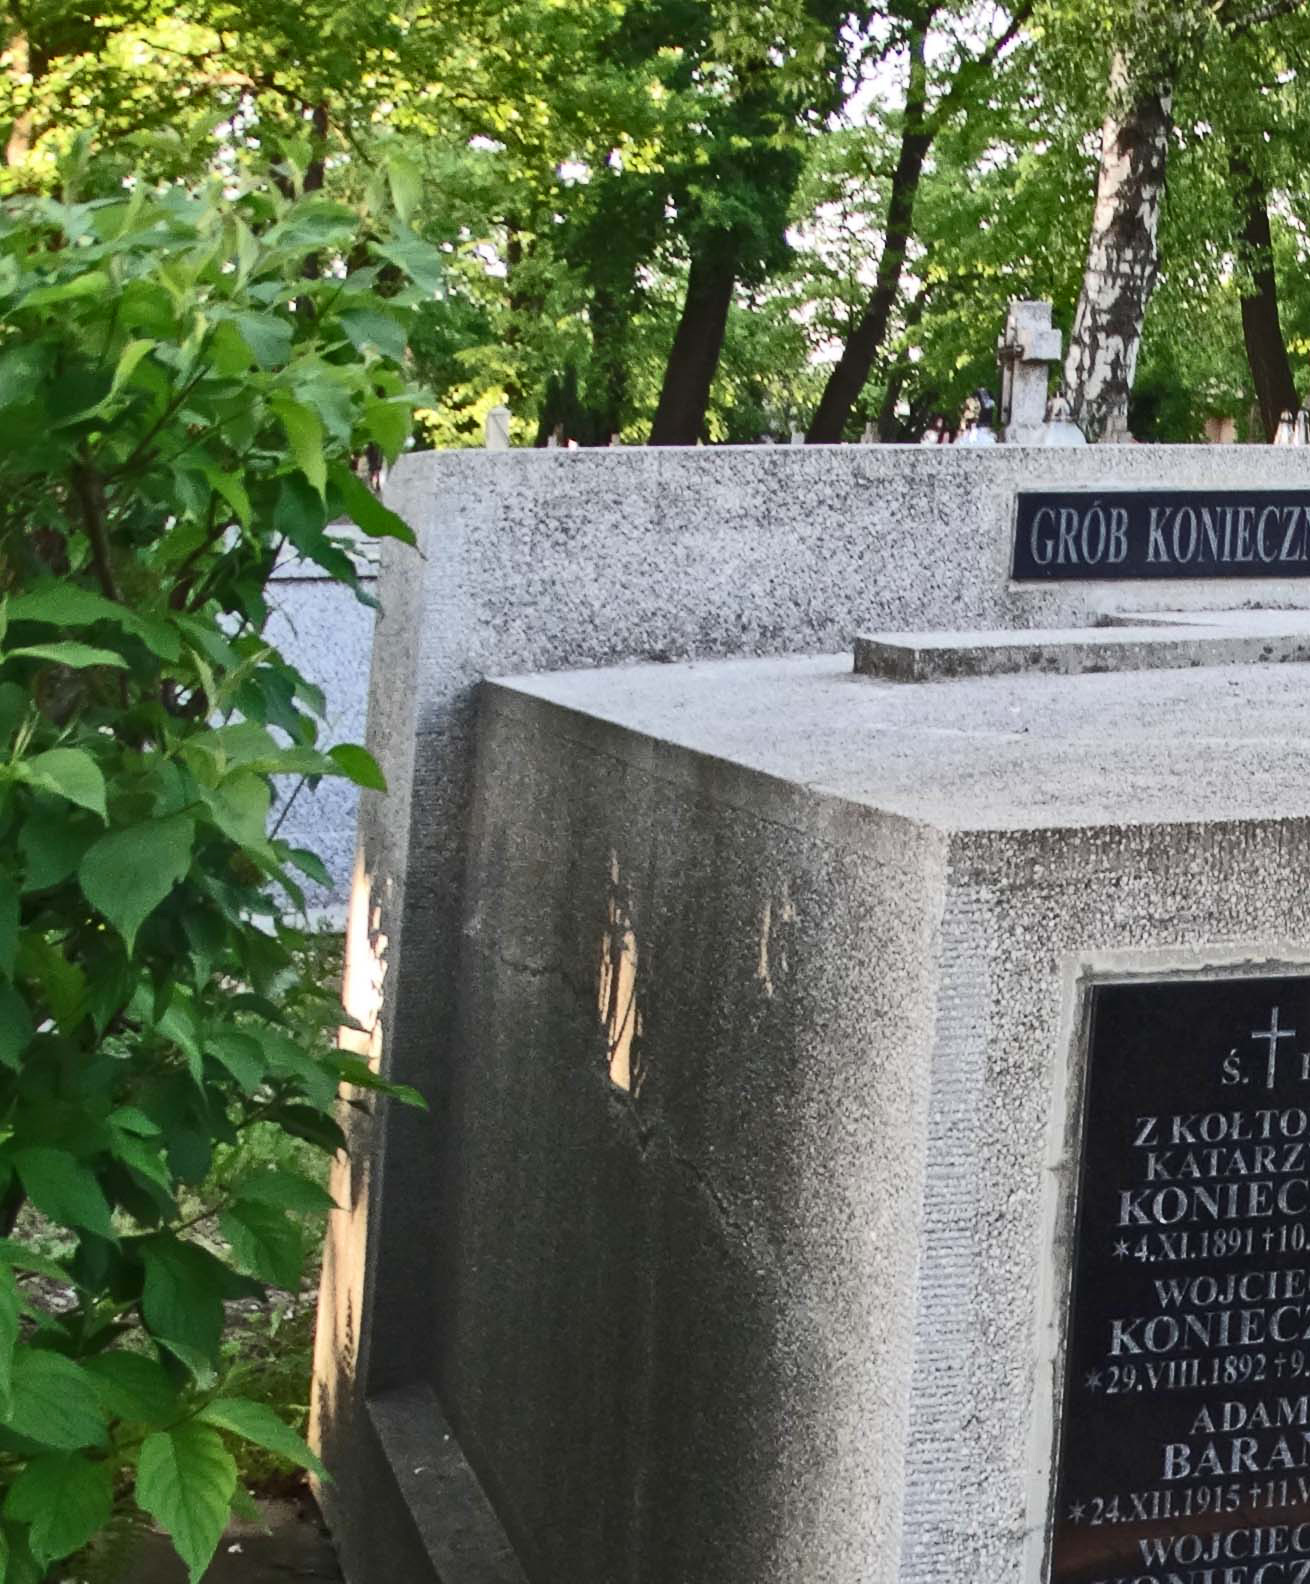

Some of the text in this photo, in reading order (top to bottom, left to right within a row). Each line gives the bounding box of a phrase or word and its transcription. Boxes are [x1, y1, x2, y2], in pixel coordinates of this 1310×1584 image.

[1030, 500, 1128, 564] GRÓB
[1133, 1117, 1158, 1146] Z
[1189, 1396, 1309, 1435] ADAM
